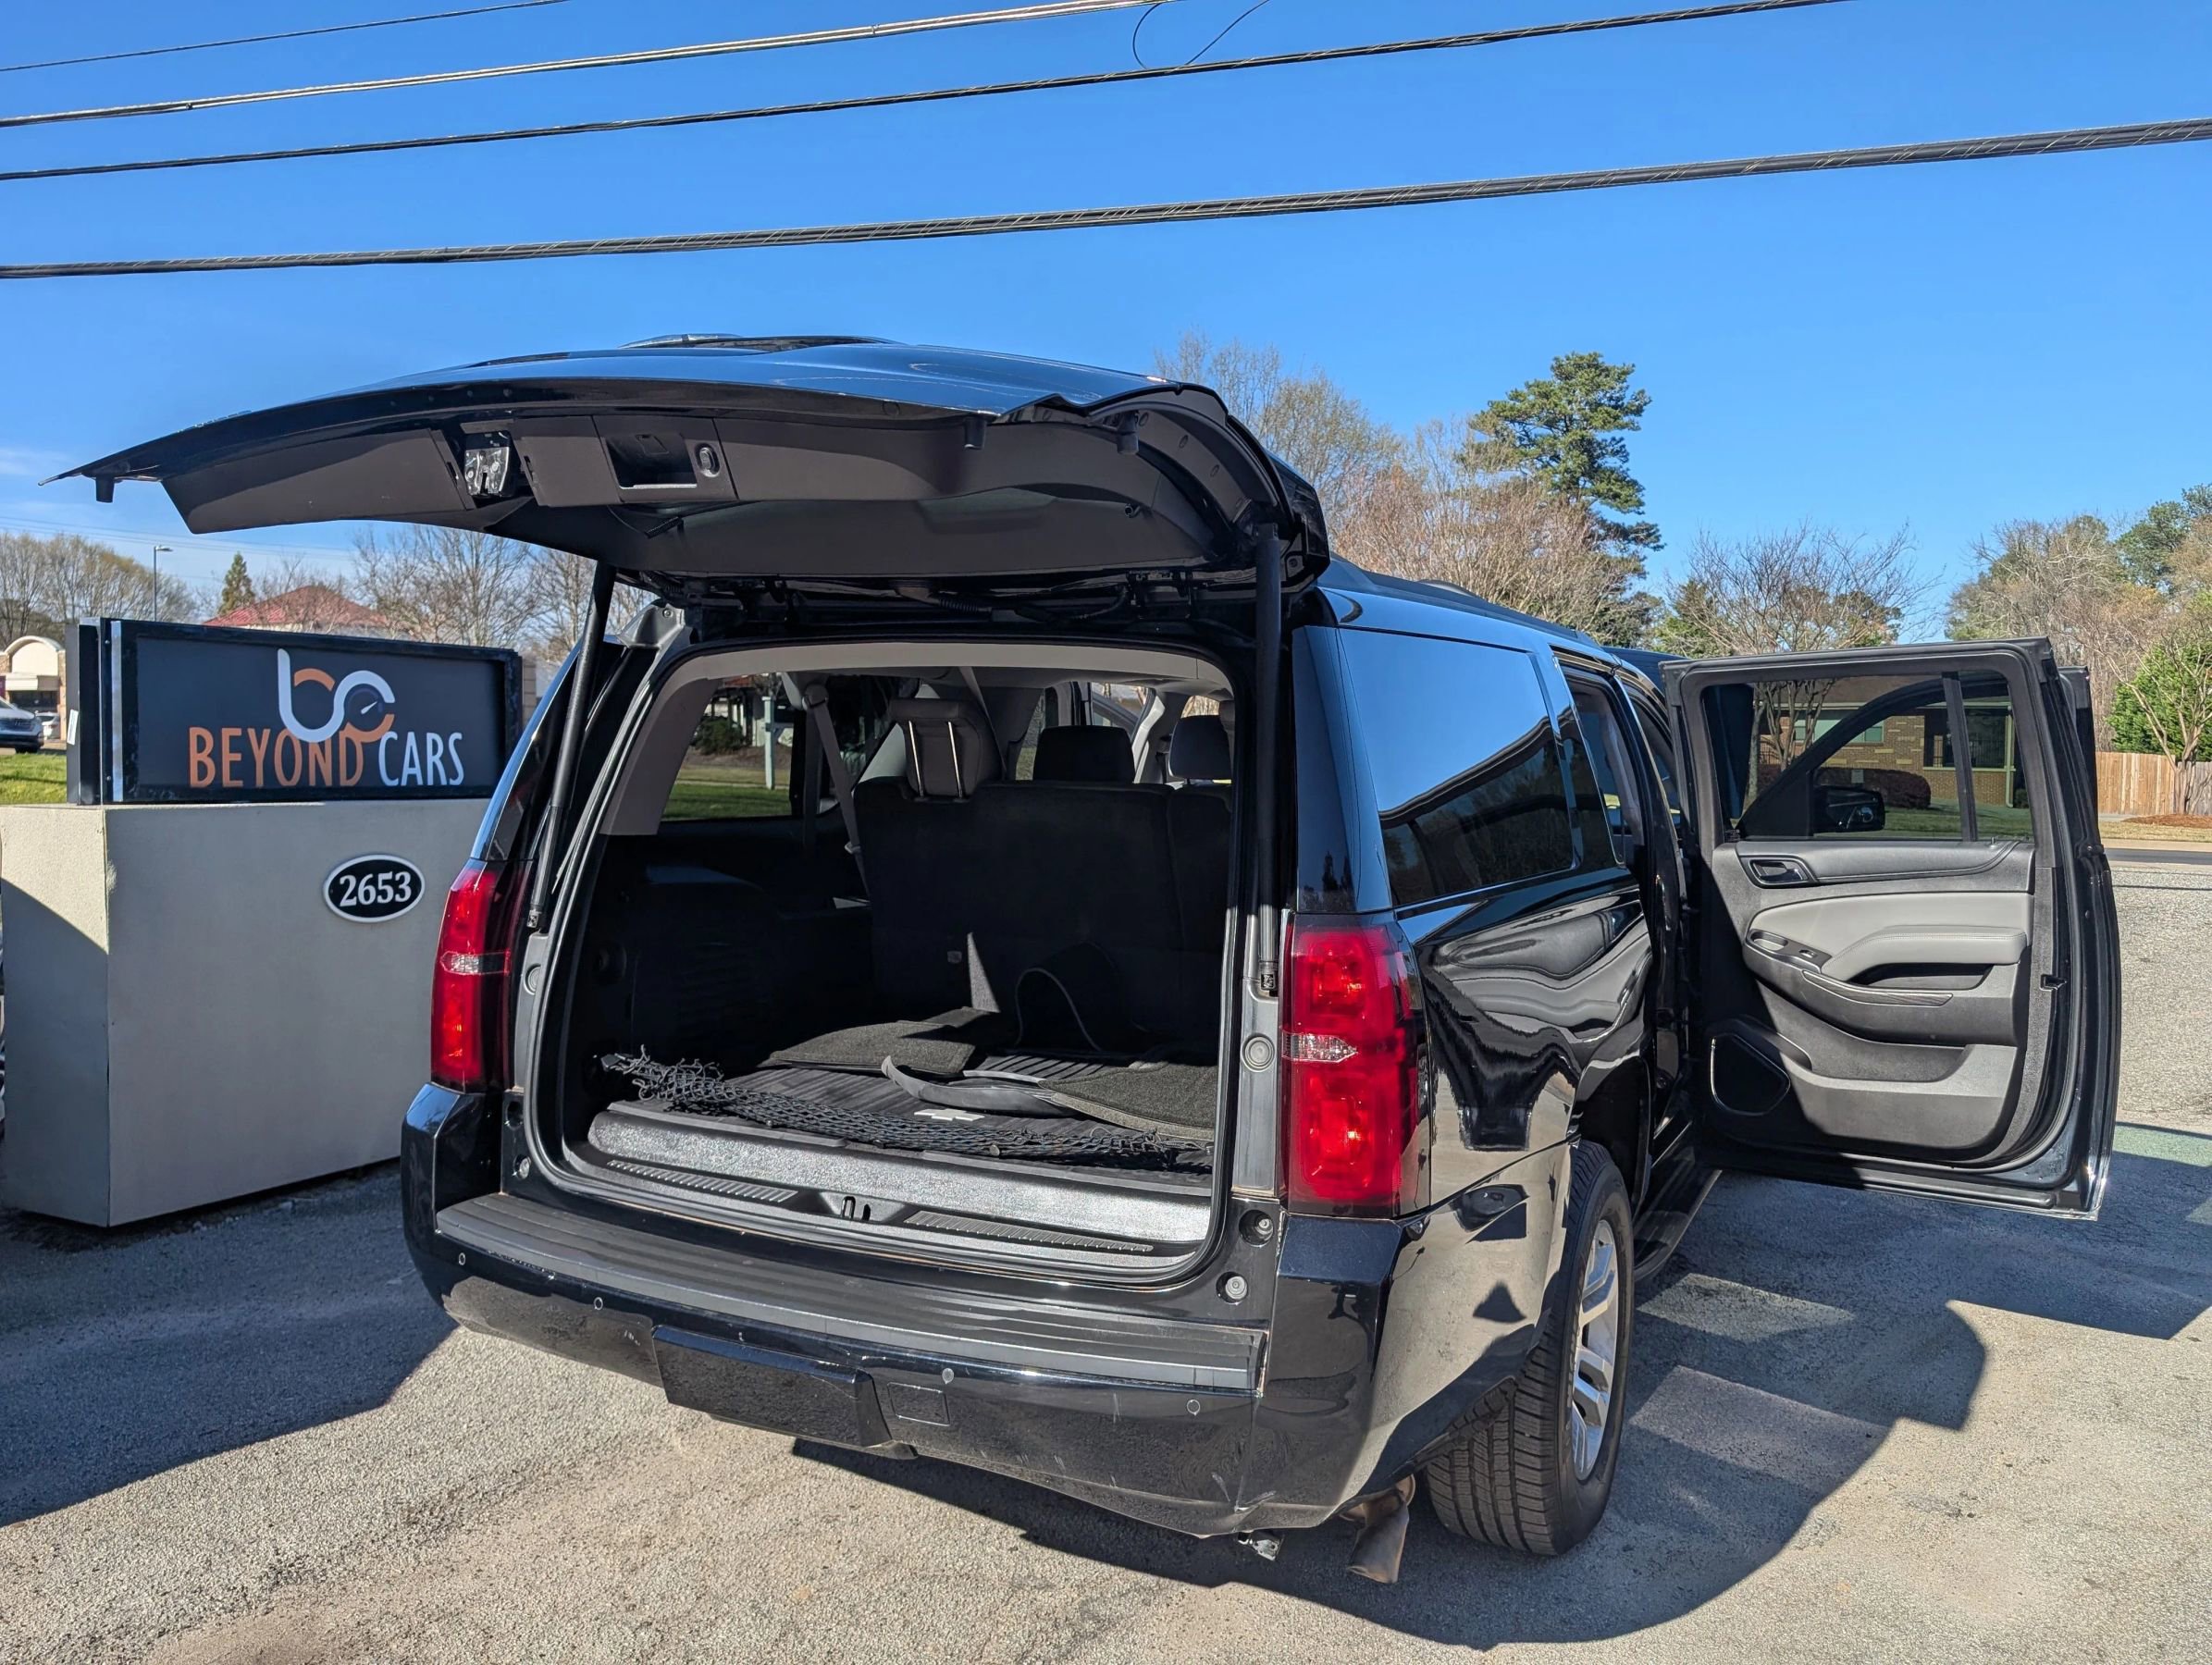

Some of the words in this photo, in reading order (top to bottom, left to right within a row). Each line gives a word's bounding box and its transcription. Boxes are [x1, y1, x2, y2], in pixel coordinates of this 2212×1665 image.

[189, 727, 365, 787] BEYOND
[378, 732, 464, 786] CARS
[340, 871, 412, 906] 2653
